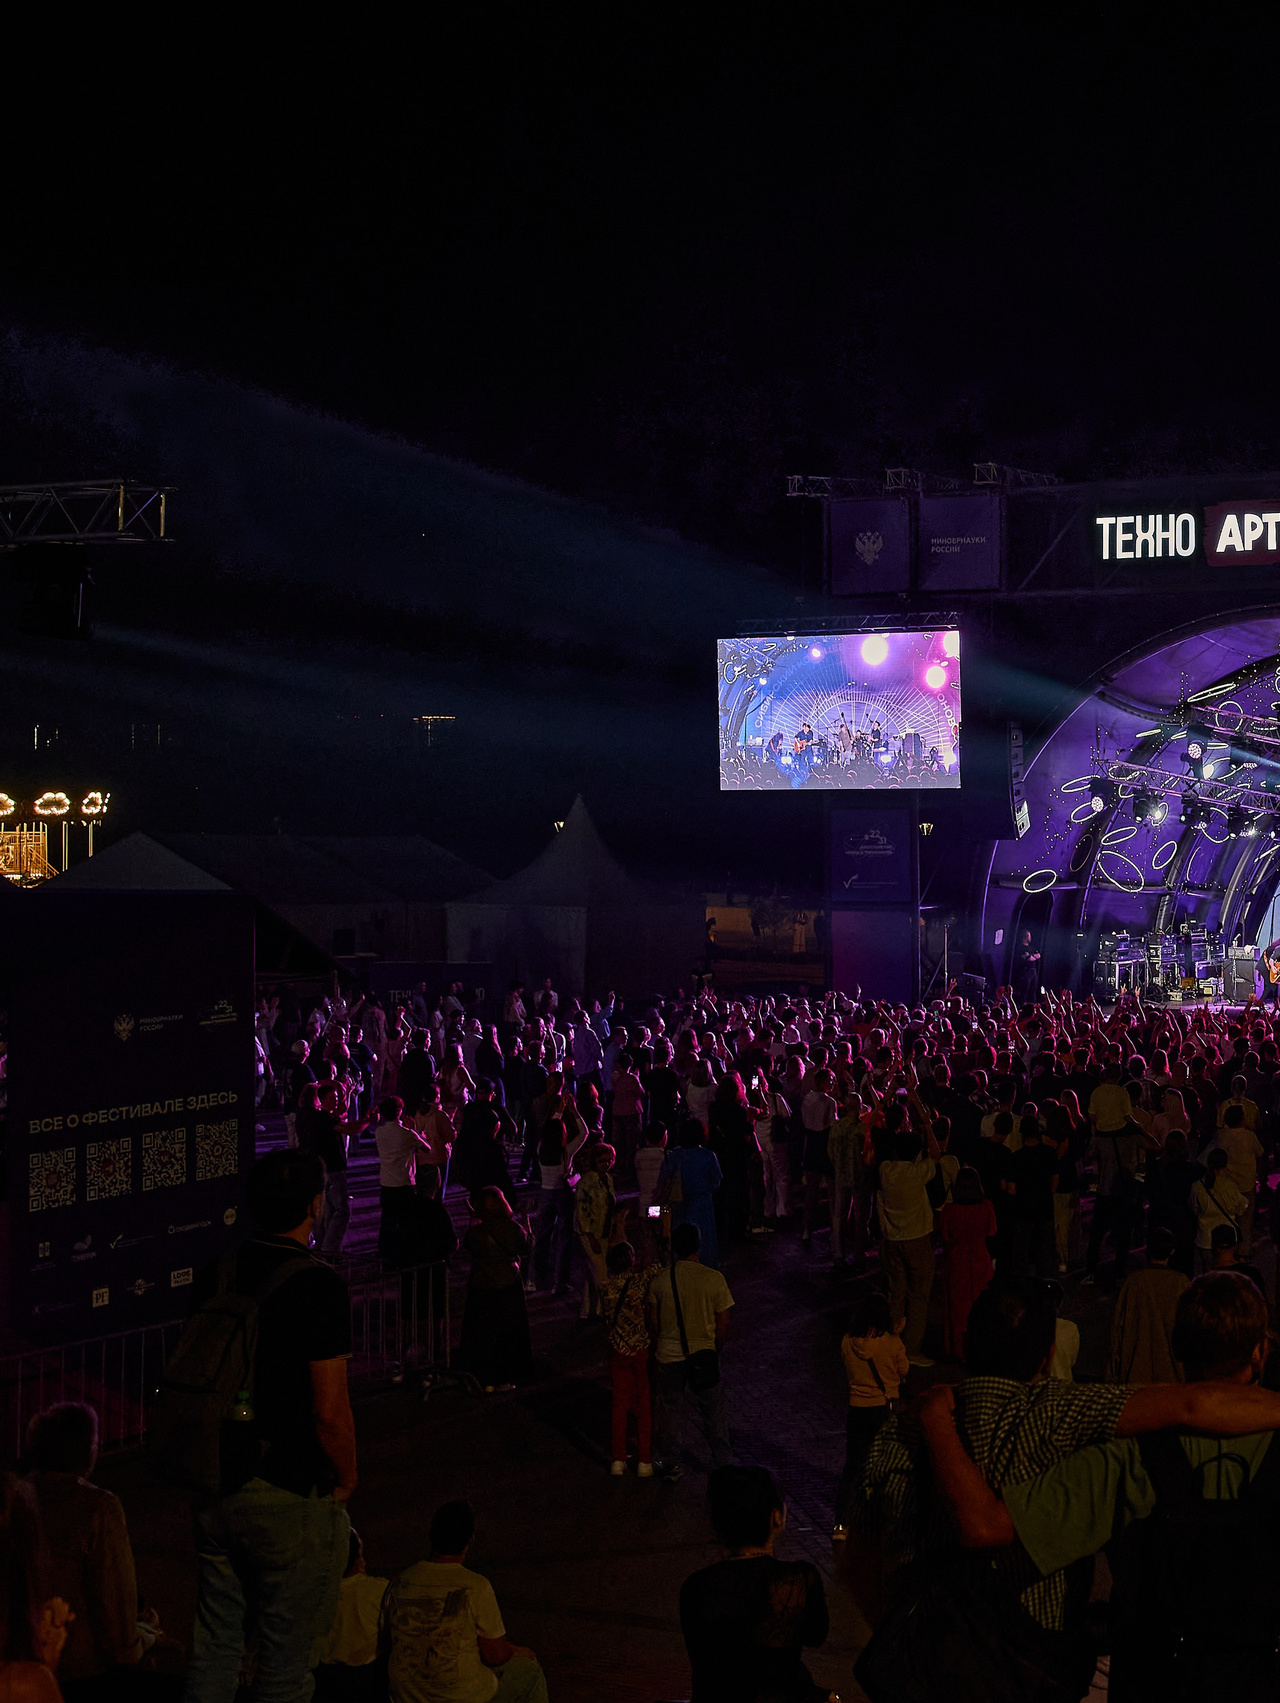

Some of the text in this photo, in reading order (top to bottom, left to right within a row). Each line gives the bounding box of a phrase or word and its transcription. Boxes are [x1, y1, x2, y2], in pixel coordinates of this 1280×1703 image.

[931, 536, 986, 546] МИНОБРНАУКИ
[931, 545, 961, 553] РОССИИ
[1096, 513, 1196, 560] ТЕХНО
[29, 1090, 239, 1134] ВСЕ О ФЕСТИВАЛЕ ЗДЕСЬ
